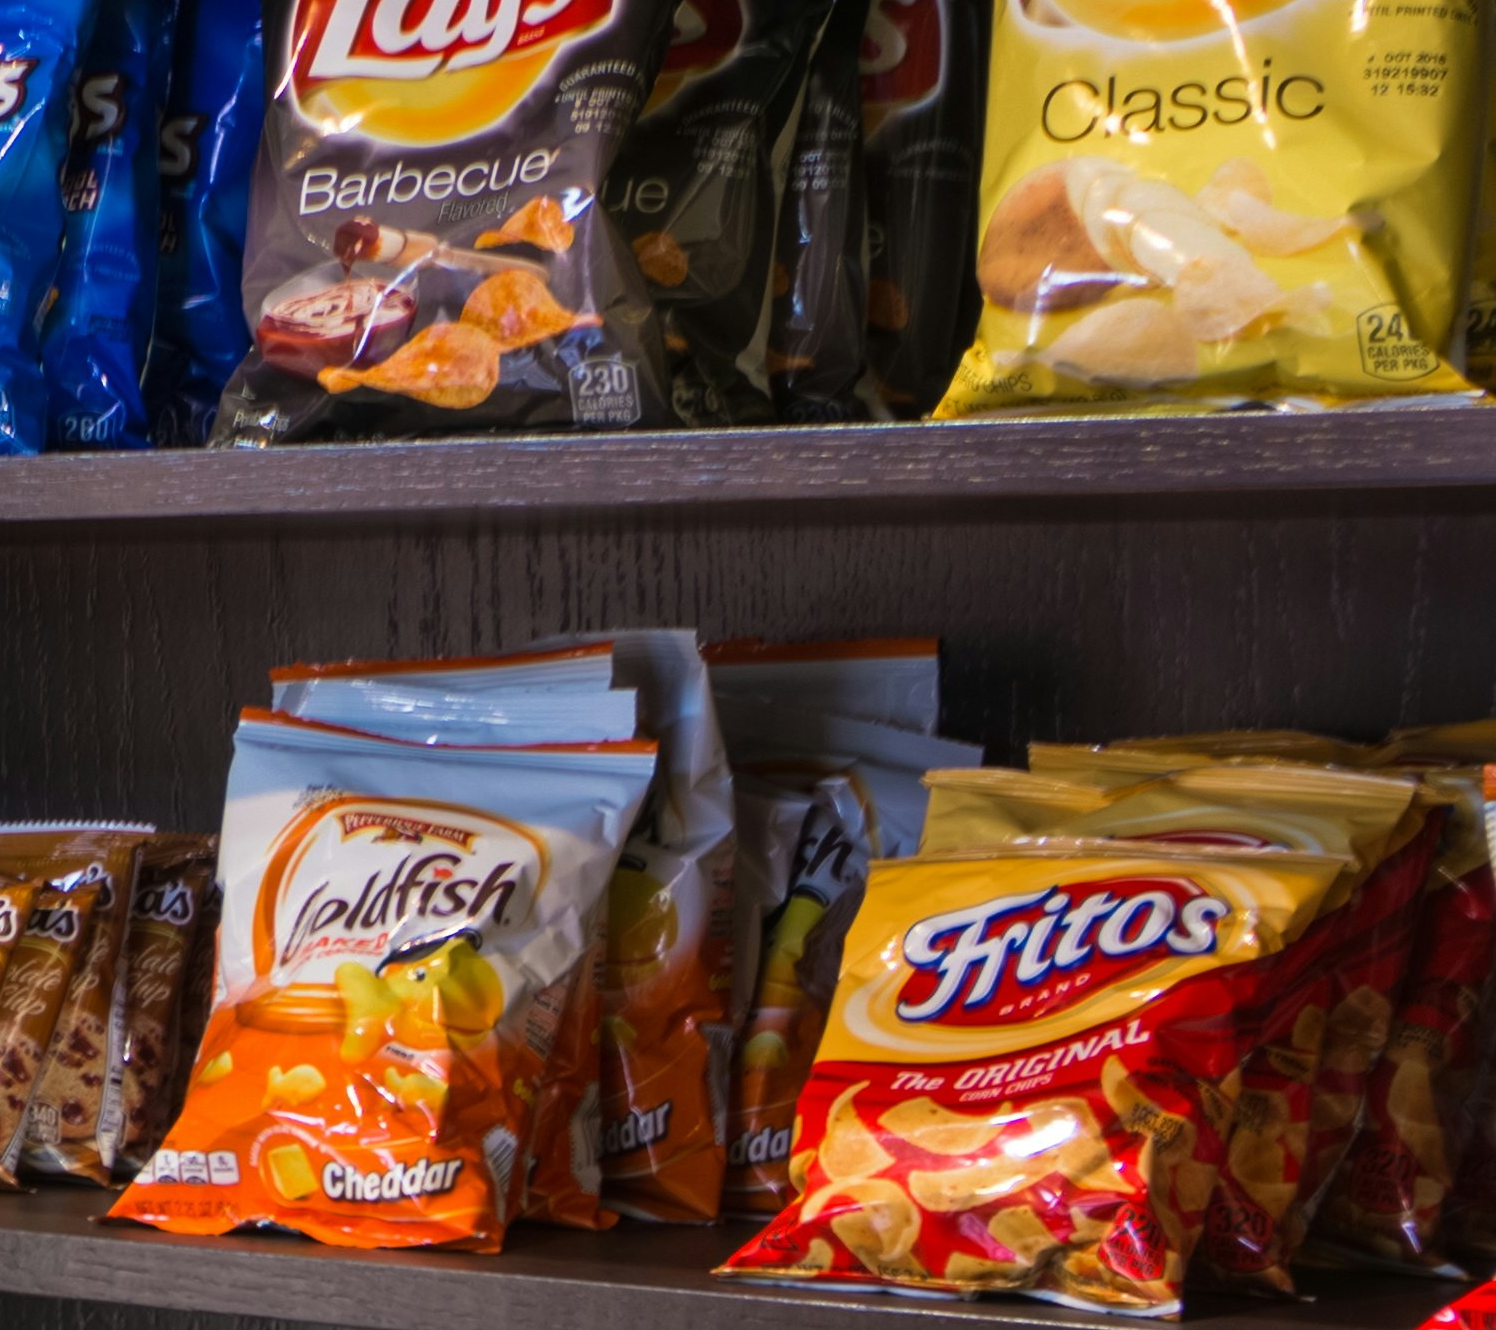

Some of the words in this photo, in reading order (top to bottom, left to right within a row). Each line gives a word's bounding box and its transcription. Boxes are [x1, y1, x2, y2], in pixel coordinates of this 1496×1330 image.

[1041, 58, 1326, 143] Classic
[1372, 85, 1388, 95] 12
[299, 148, 555, 215] Barbecue
[578, 368, 630, 396] 230
[1372, 360, 1399, 374] PER
[578, 396, 633, 410] CALORIES
[427, 822, 466, 841] FARM
[280, 852, 516, 967] Goldfish
[896, 886, 1232, 1023] Fritos
[998, 972, 1092, 1018] BRAND
[891, 1070, 946, 1092] The
[954, 1018, 1153, 1092] ORIGINAL
[960, 1081, 1001, 1102] CORN
[1004, 1073, 1053, 1096] CHIPS
[323, 1157, 464, 1202] Cheddar
